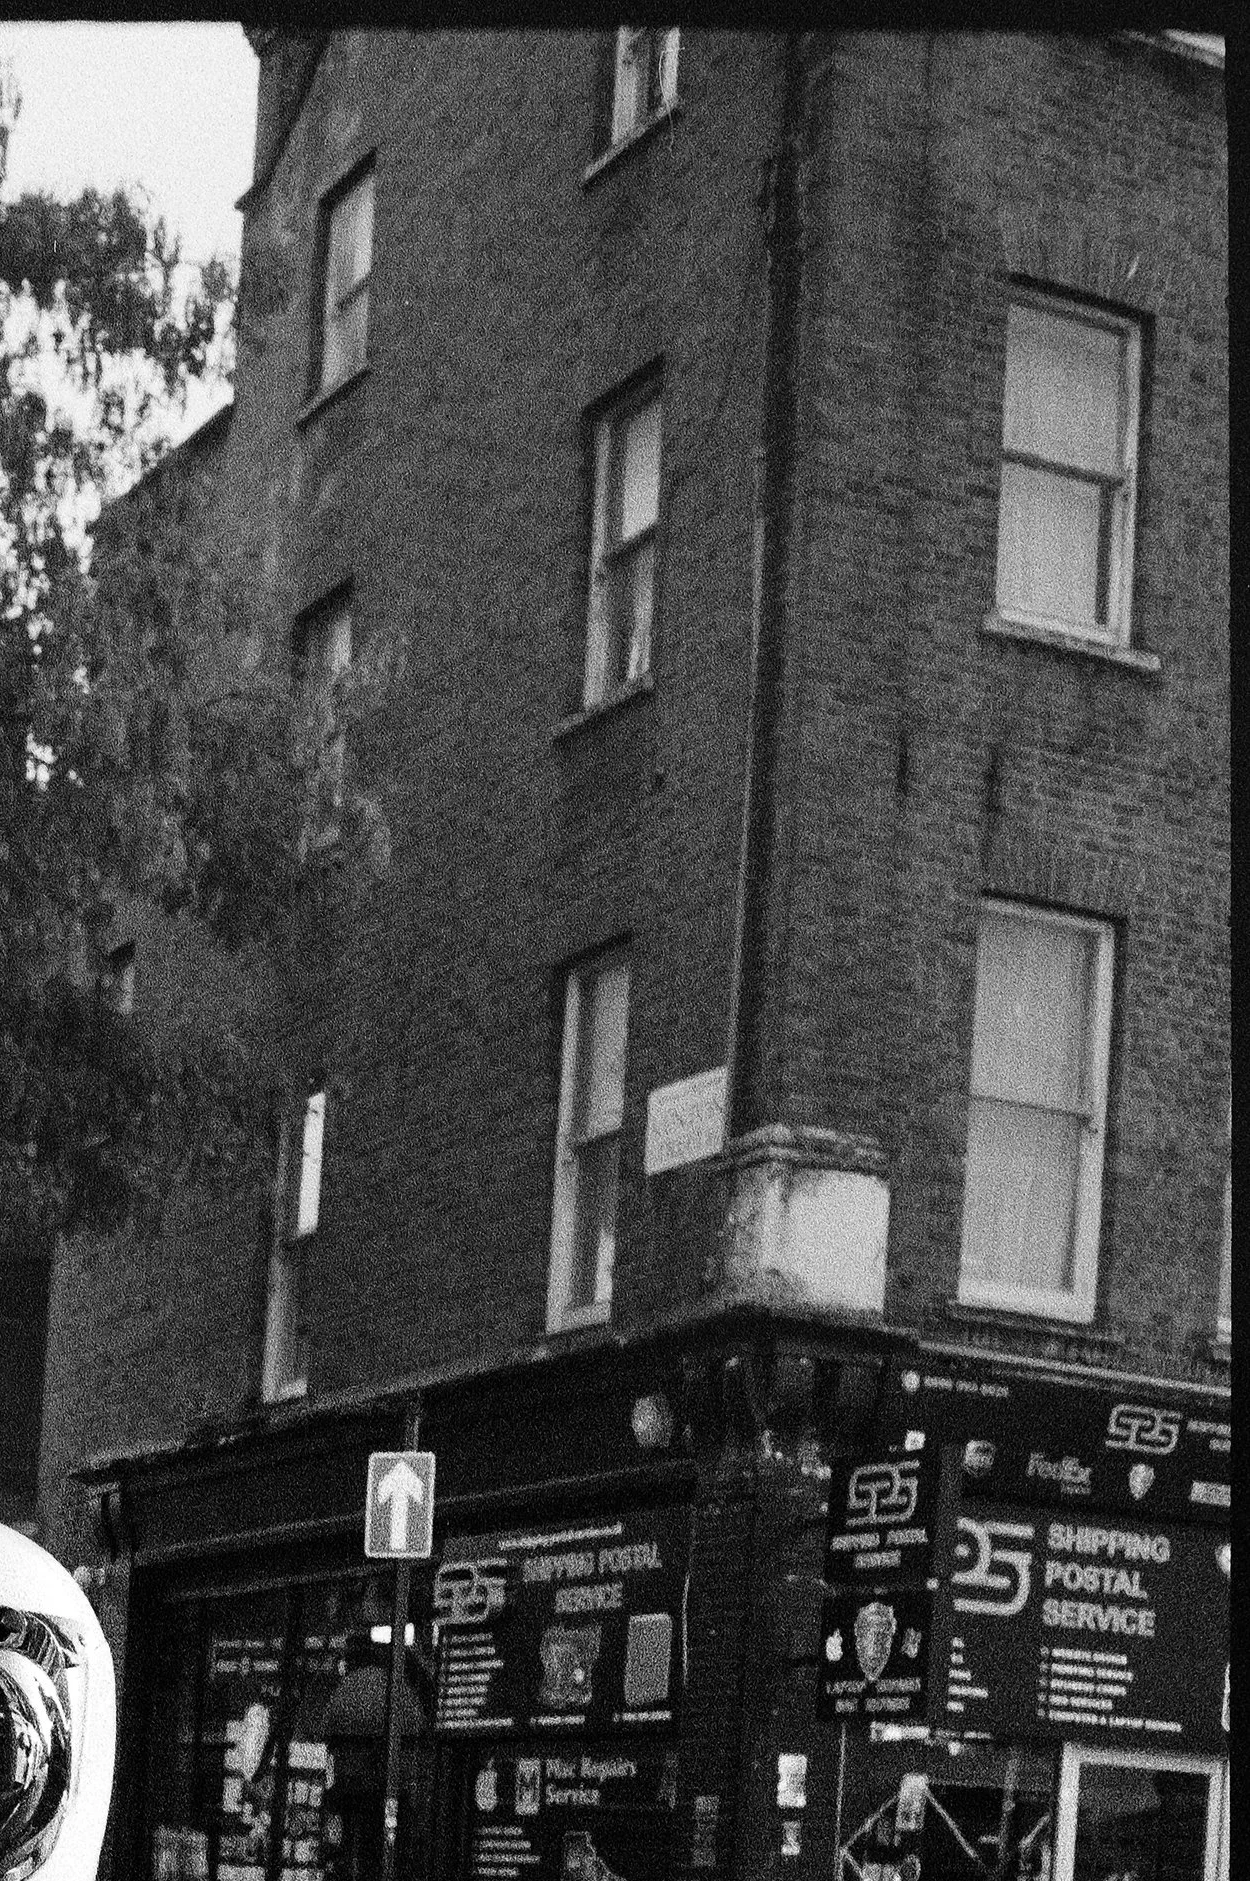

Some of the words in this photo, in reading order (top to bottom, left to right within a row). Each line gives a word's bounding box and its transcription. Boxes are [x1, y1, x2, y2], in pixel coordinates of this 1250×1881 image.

[522, 1551, 596, 1583] SHIPPING
[598, 1541, 663, 1574] POSTAL
[1046, 1522, 1171, 1564] SHIPPING
[554, 1581, 624, 1615] SERVICE
[1044, 1560, 1149, 1599] POSTAL
[1042, 1598, 1157, 1639] SERVICE
[545, 1758, 575, 1778] Mac
[580, 1756, 637, 1784] Repairs
[545, 1783, 601, 1806] Service
